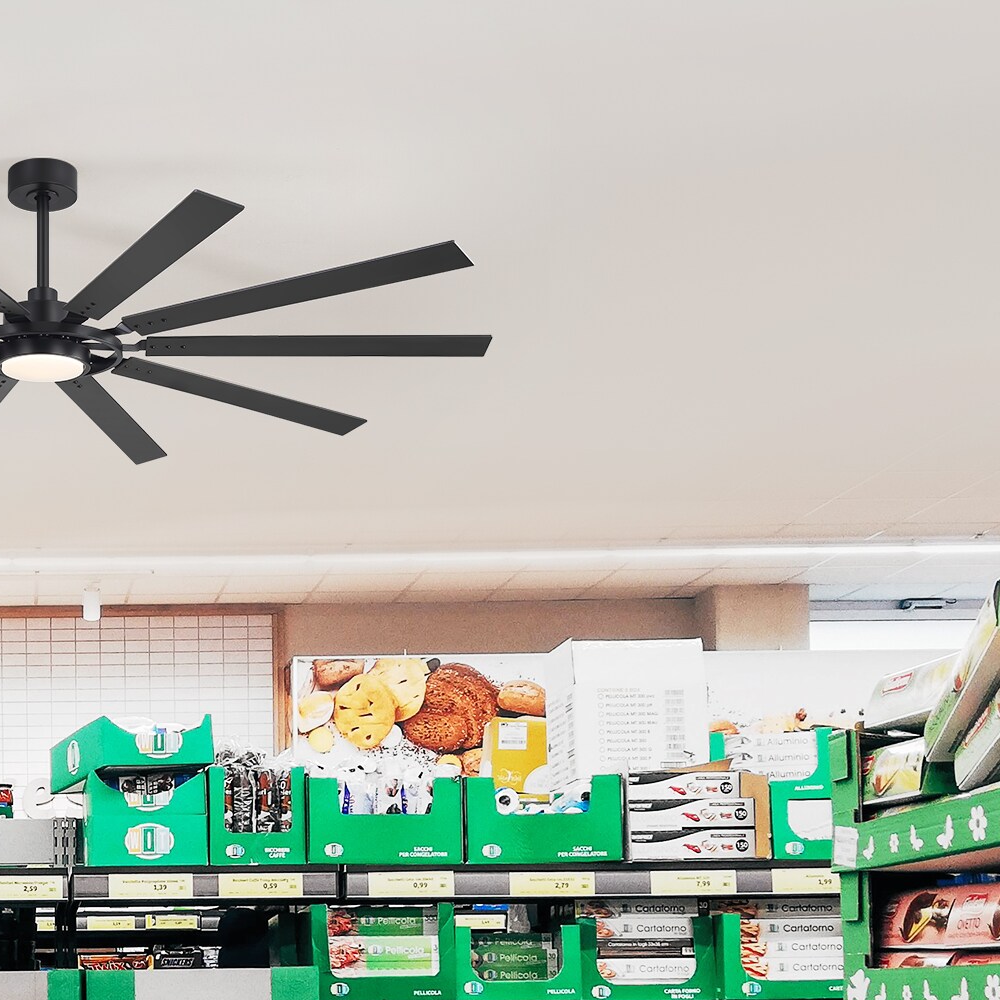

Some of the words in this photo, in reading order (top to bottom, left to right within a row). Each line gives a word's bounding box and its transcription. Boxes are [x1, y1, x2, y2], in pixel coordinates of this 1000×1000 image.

[767, 737, 808, 746] Alluminio
[768, 753, 809, 762] Alluminio
[769, 770, 811, 778] Alluminio
[818, 878, 832, 886] 1,99
[635, 904, 686, 912] Cartaforno
[782, 904, 832, 912] Cartaforno
[378, 916, 416, 925] Pellicola
[636, 924, 686, 932] Cartaforno
[783, 924, 834, 932] Cartaforno
[386, 946, 424, 954] Pellicola
[792, 942, 842, 951] Cartaforno
[500, 954, 538, 962] Pellicola
[161, 958, 195, 968] SNICKERS
[792, 962, 844, 972] Cartaforno
[639, 964, 690, 973] Cartaforno
[500, 970, 538, 980] Pellicola
